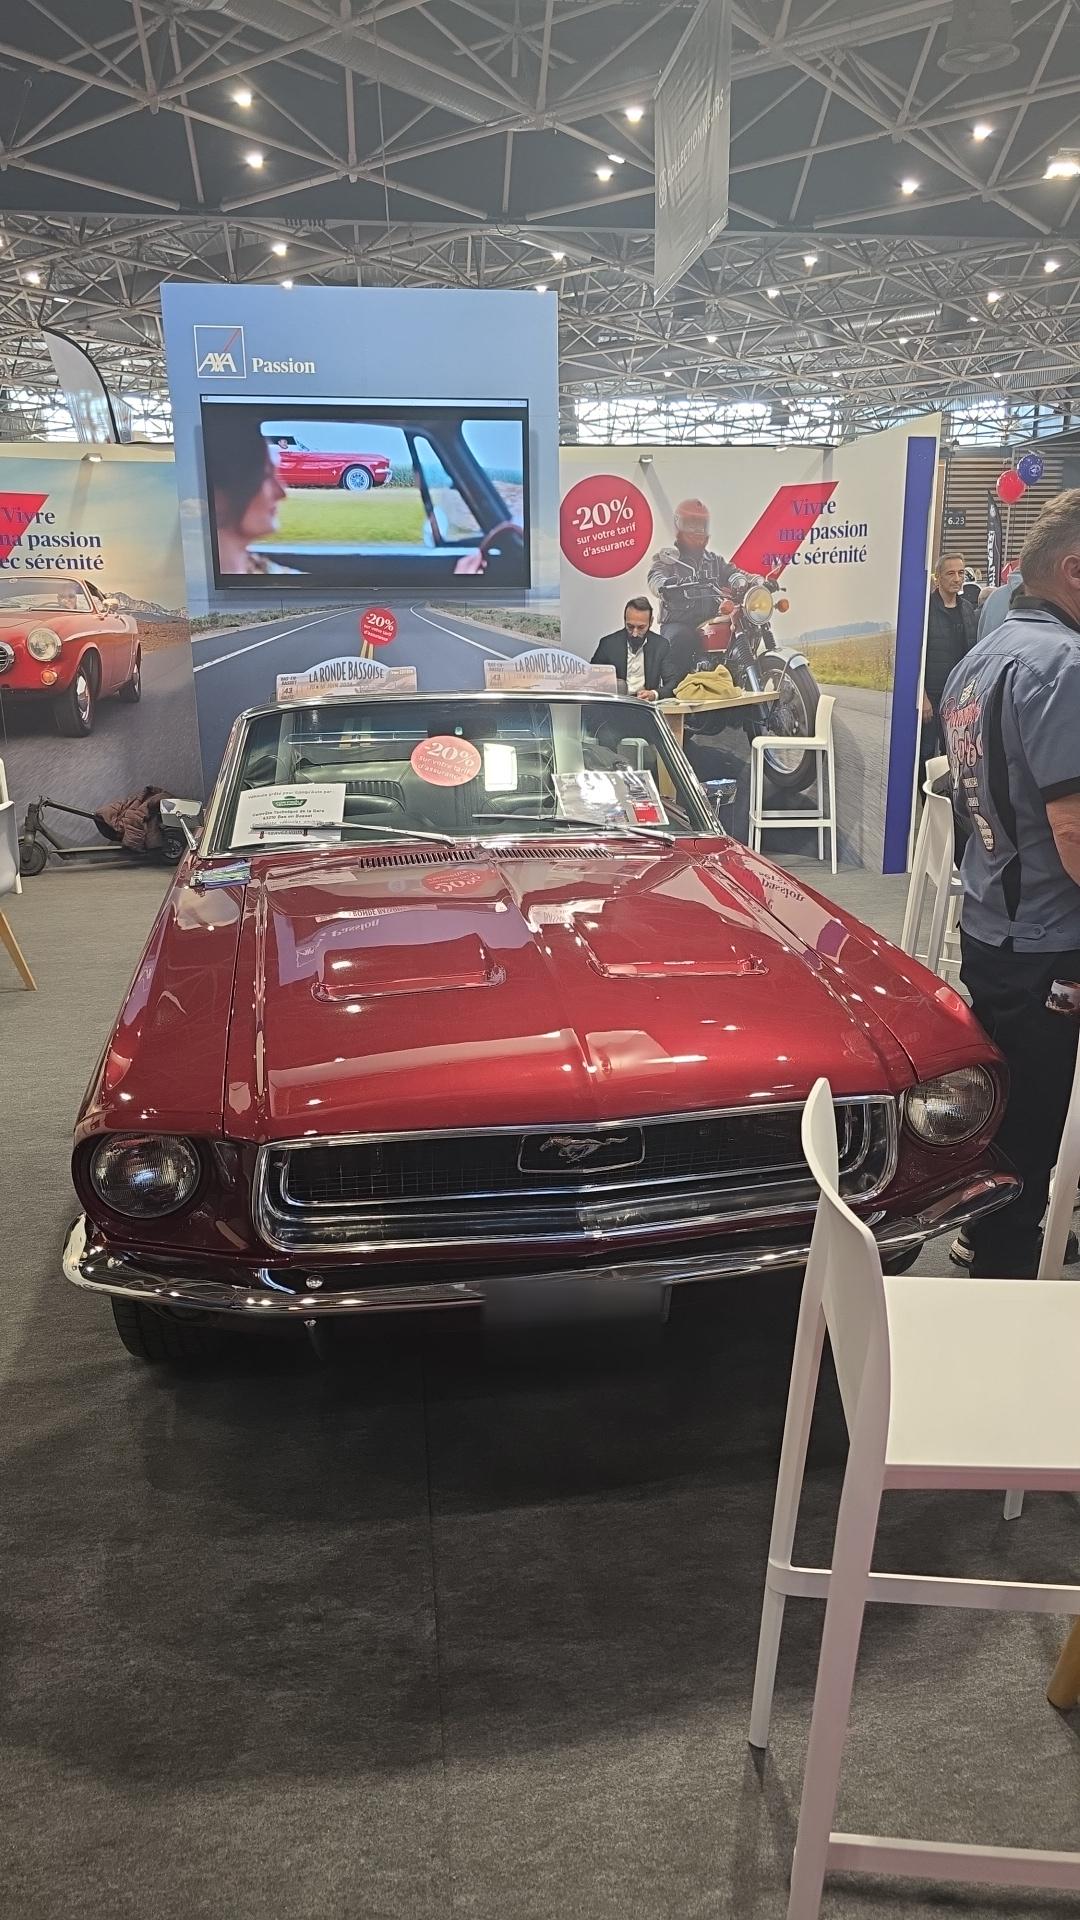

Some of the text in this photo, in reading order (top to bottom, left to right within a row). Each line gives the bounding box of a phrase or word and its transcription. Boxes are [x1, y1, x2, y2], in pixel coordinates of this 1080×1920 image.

[199, 352, 317, 374] AXA Passion
[2, 506, 56, 525] Vivre
[572, 495, 635, 531] -20%
[793, 499, 837, 516] Vivre
[947, 516, 965, 525] 6.23
[28, 531, 101, 550] passion
[576, 521, 637, 545] sur votre tarif
[779, 520, 868, 545] ma passion
[582, 538, 636, 557] d'assurance
[762, 544, 868, 566] avec sérénité
[25, 553, 105, 570] sérénité
[366, 613, 394, 632] -20%
[309, 660, 385, 683] LA RONDE BASSOISE
[515, 653, 586, 675] LA RONDE BASSOISE
